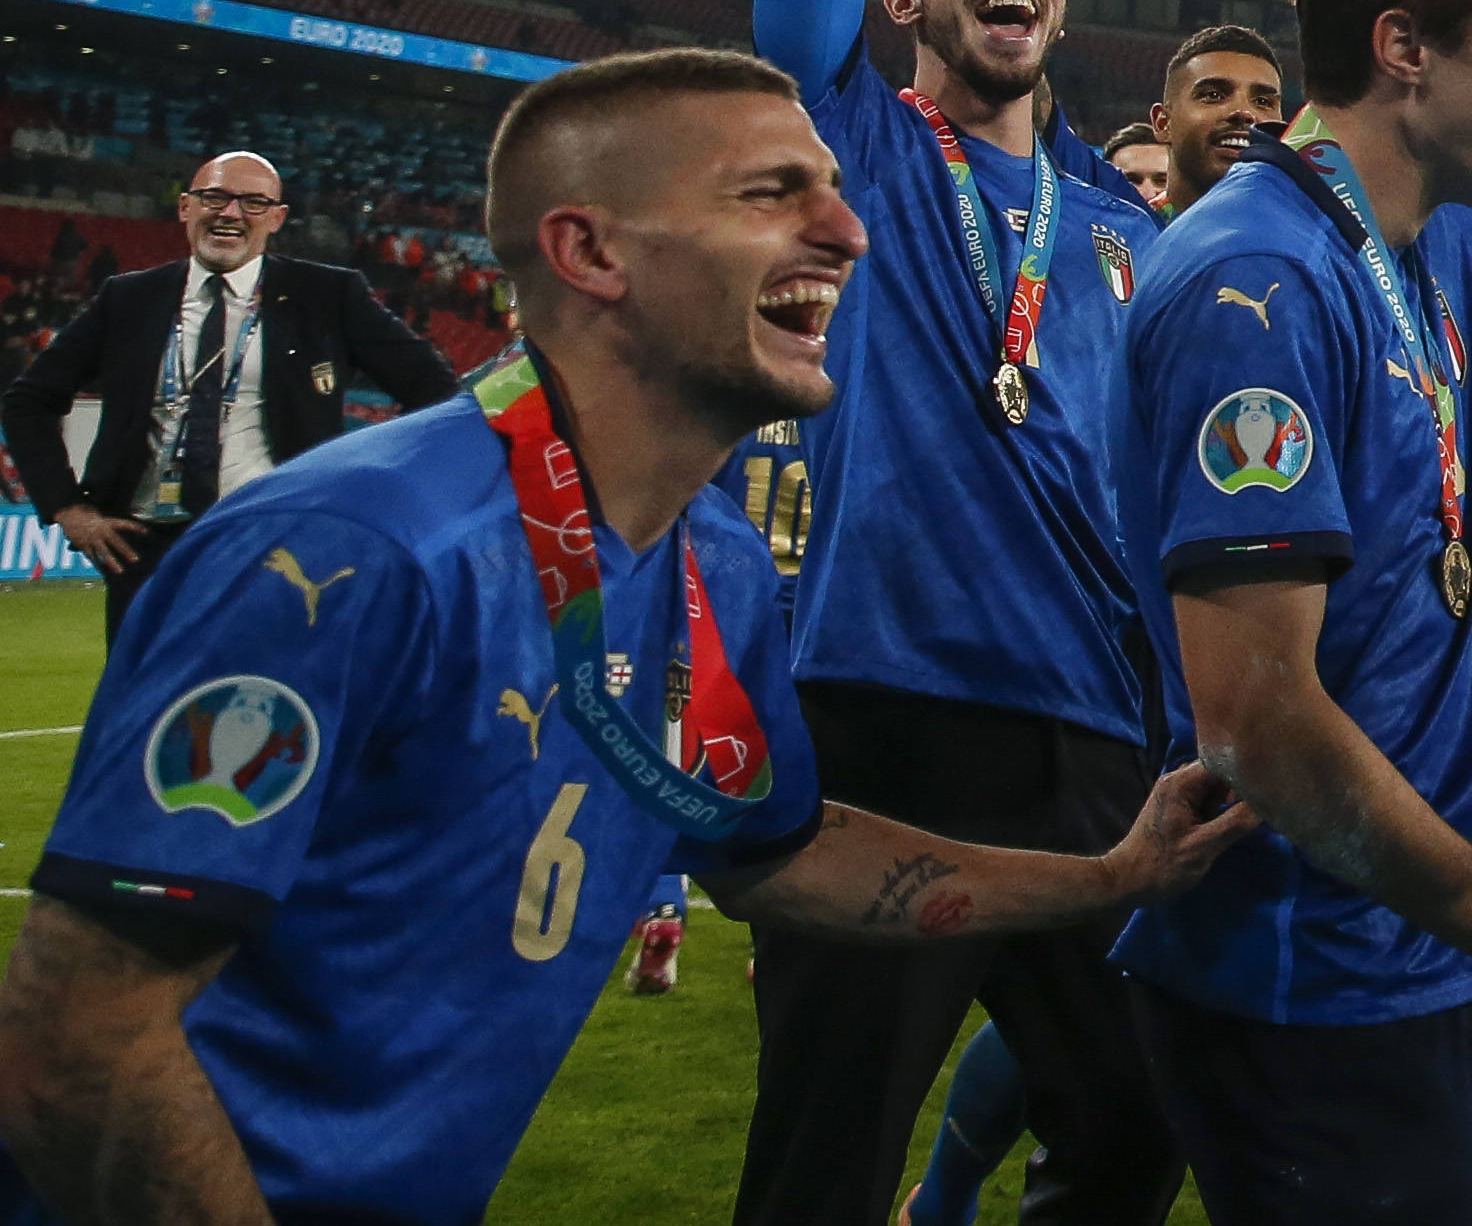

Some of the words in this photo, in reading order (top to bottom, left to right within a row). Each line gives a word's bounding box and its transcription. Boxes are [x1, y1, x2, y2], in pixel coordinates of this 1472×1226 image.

[290, 16, 347, 47] EURO
[350, 28, 404, 57] 2020
[1039, 181, 1054, 215] EURO
[965, 229, 986, 271] EURO
[1032, 213, 1049, 249] 2020
[1096, 237, 1129, 261] ITALIA
[1386, 292, 1416, 343] 2020
[744, 456, 812, 577] 10
[573, 661, 609, 725] 2020
[601, 723, 662, 787] EURO
[657, 780, 719, 825] UEFA
[511, 782, 590, 962] 6
